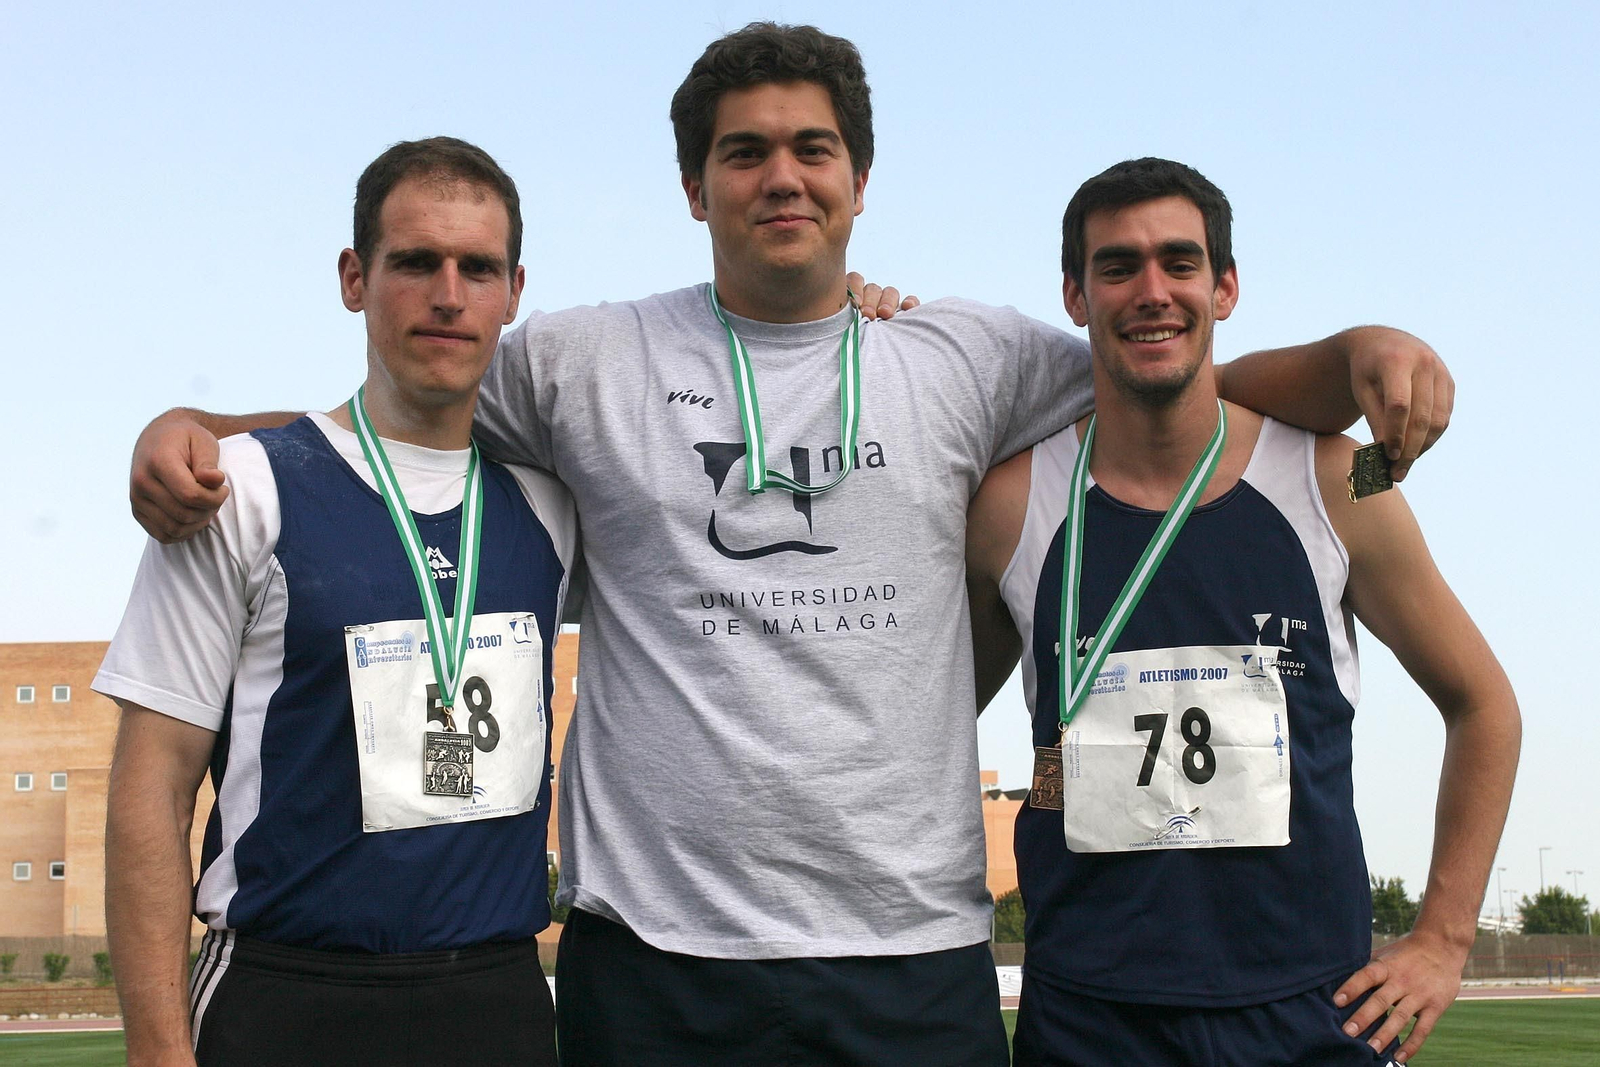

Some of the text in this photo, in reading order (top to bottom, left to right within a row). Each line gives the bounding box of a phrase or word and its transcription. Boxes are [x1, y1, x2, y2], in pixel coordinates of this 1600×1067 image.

[700, 584, 897, 609] UNIVERSIDAD
[702, 612, 898, 636] DE MÁLAGA
[477, 634, 502, 649] 2007
[1139, 667, 1229, 684] ATLETISMO 2007
[1134, 706, 1217, 786] 78
